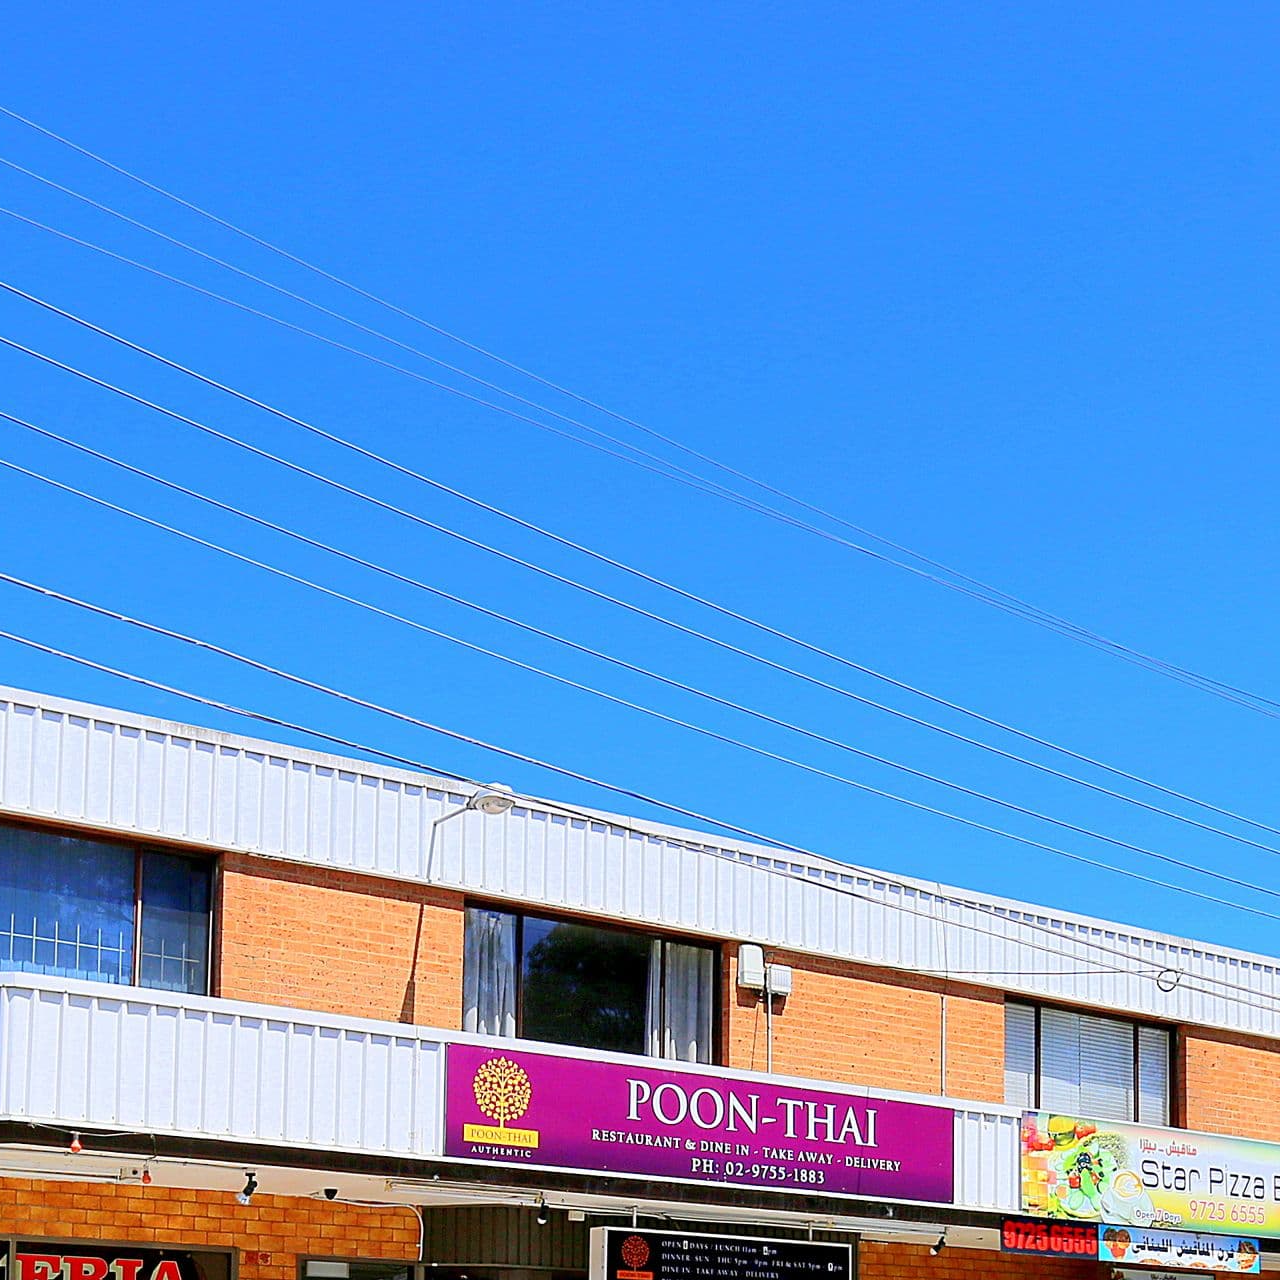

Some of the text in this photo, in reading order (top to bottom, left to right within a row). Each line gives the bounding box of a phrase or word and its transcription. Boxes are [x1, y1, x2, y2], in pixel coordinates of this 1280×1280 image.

[625, 1078, 879, 1148] POON-THAI
[470, 1127, 534, 1144] POON-THAI
[471, 1146, 532, 1158] AUTHENTIC
[591, 1128, 902, 1172] RESTAURANT & DINE IN TAKE AWAY DELIVERY
[690, 1158, 825, 1184] PH: 02-9755-1883
[1141, 1159, 1201, 1192] Star
[1209, 1164, 1266, 1200] Pizza
[1135, 1209, 1182, 1224] Open 7 Days
[1189, 1200, 1266, 1224] 9725 6555
[661, 1240, 681, 1248] OPEN
[689, 1242, 708, 1250] DAYS
[1003, 1220, 1098, 1255] 9725 6555
